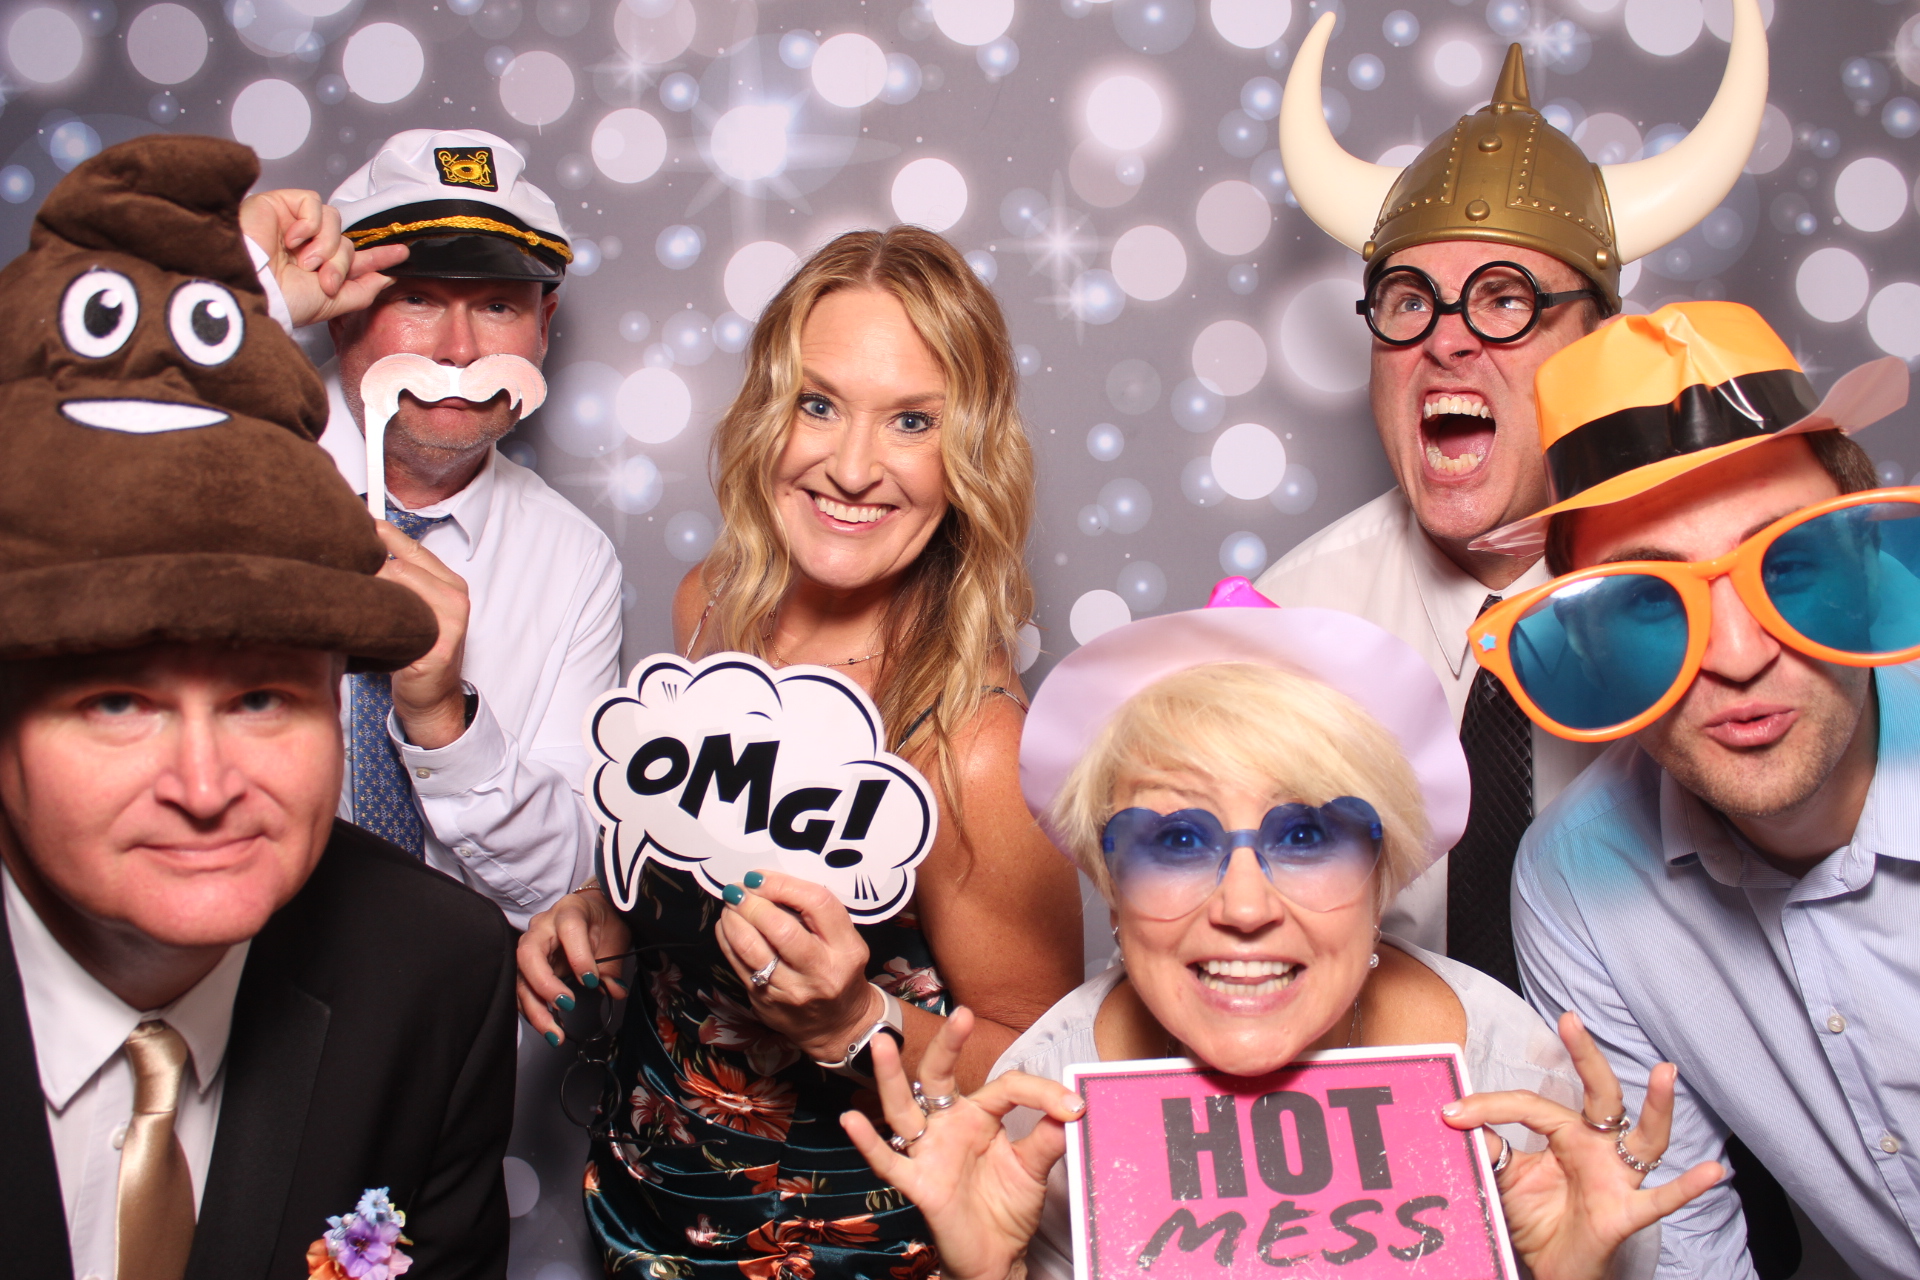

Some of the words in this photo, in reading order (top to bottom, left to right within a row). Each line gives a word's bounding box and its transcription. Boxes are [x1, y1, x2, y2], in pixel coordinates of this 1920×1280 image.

[626, 733, 891, 869] OMG!
[1161, 1086, 1394, 1201] HOT
[1136, 1195, 1449, 1271] MESS
